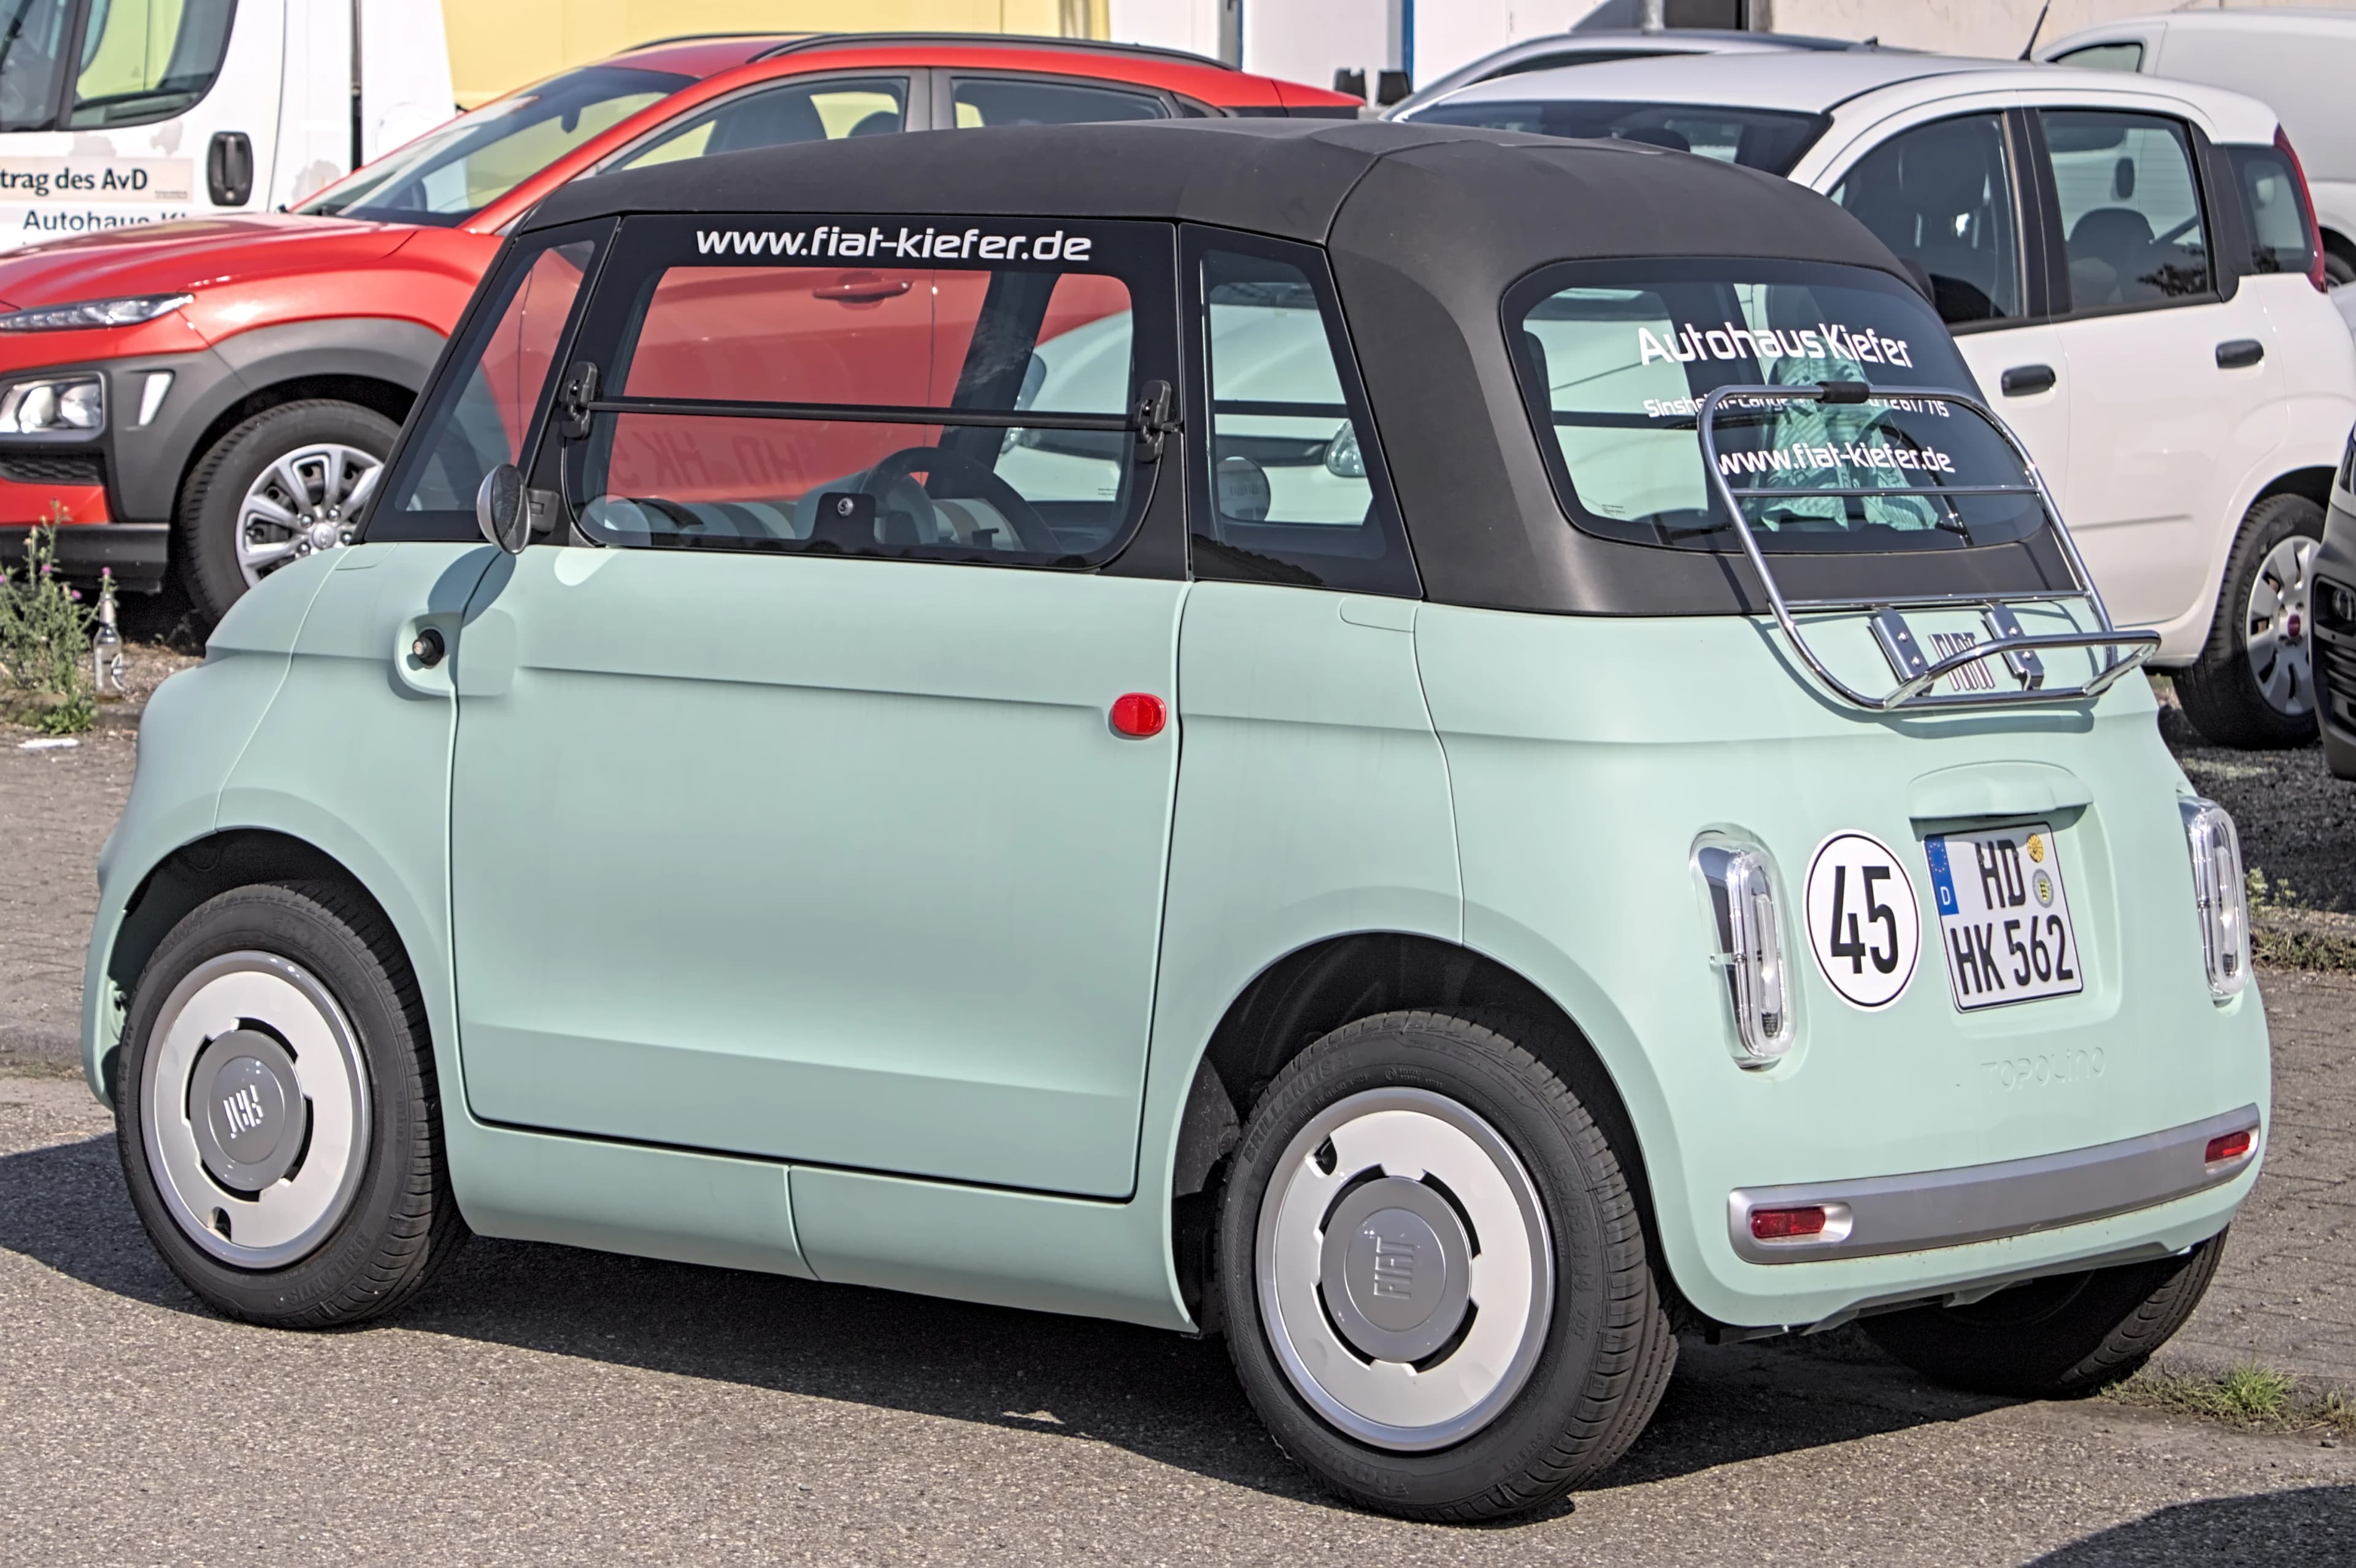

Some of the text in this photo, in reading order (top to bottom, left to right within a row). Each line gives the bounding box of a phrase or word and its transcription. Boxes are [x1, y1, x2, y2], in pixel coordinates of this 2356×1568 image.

[55, 167, 95, 190] des
[101, 167, 148, 190] AvD
[696, 226, 1092, 261] www.fiat-kiefer.de
[1719, 441, 1956, 476] www.fiat-kiefer.de
[1940, 886, 1952, 907] D
[1974, 839, 2027, 910] HD
[1830, 865, 1899, 975] 45
[1950, 914, 2074, 995] HK 562
[1373, 1235, 1415, 1300] FIAT
